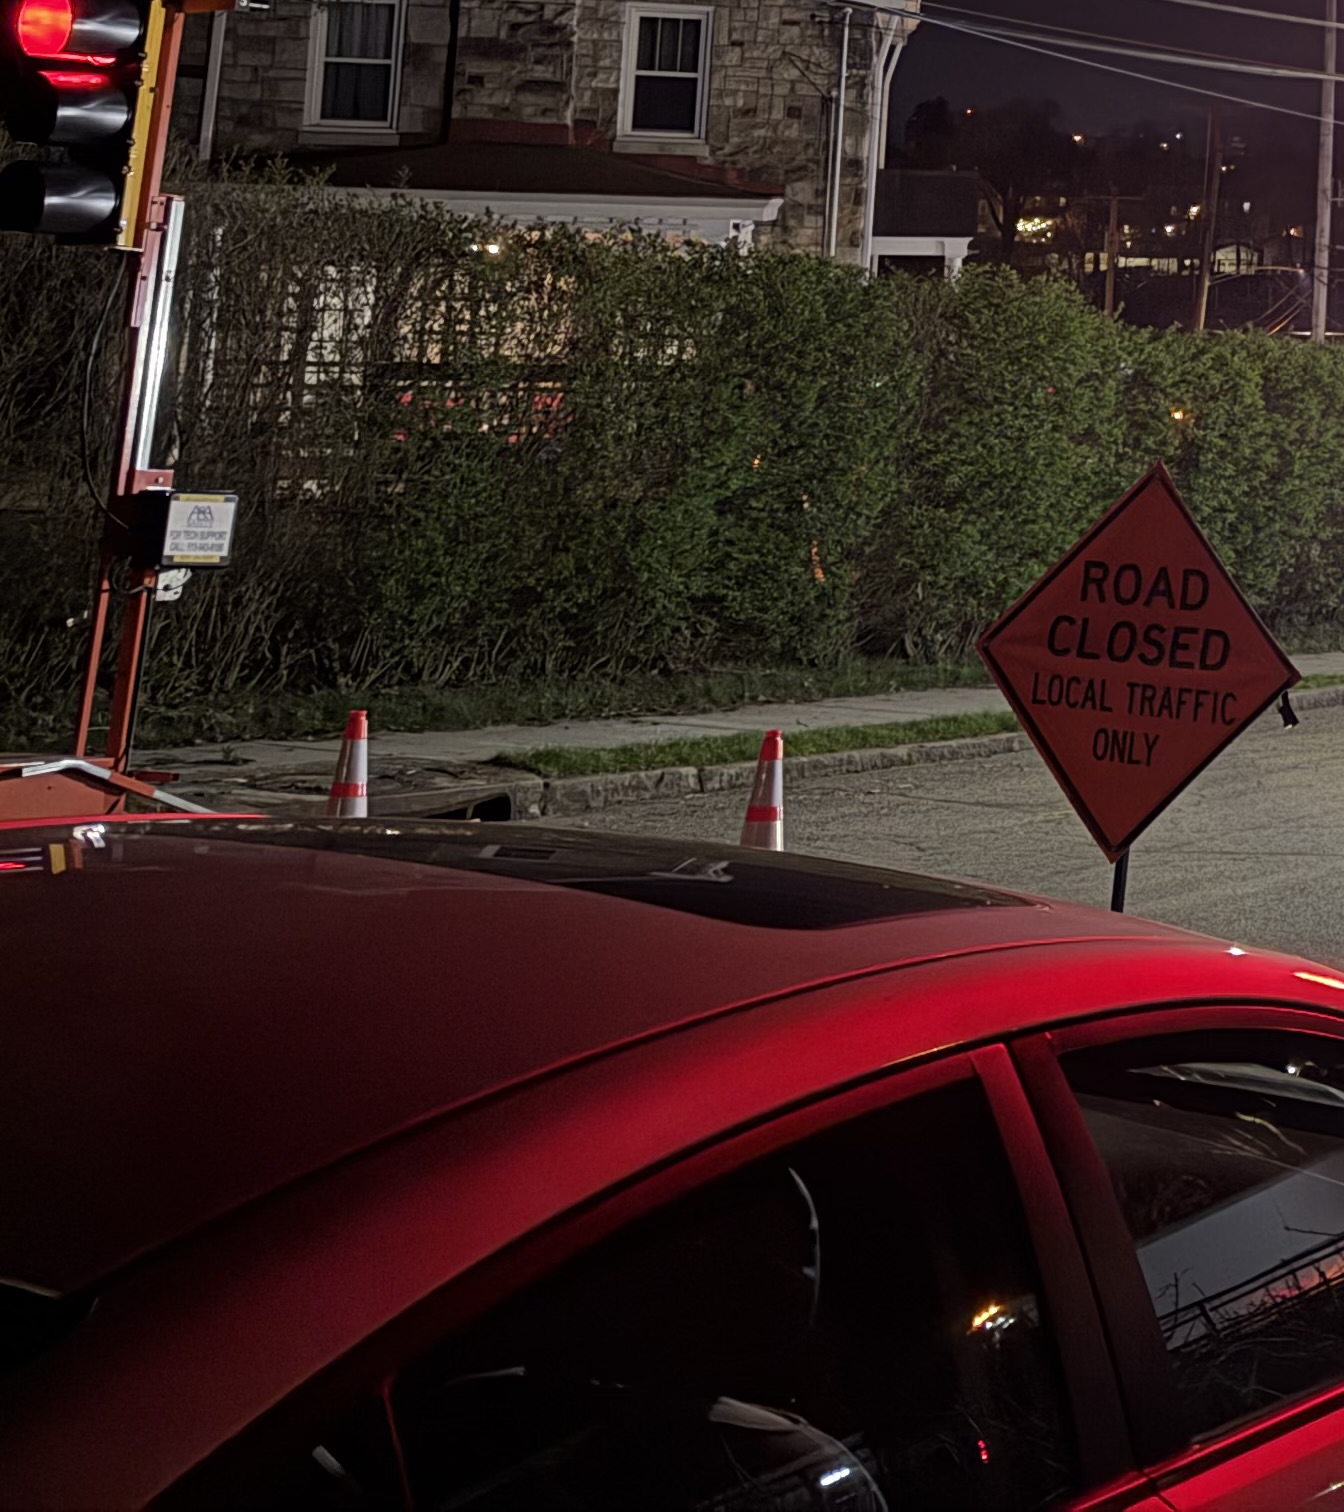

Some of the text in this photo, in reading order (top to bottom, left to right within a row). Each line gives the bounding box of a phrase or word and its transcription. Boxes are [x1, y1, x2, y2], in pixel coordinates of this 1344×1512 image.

[199, 530, 228, 541] SUPPORT
[1080, 559, 1210, 611] ROAD
[1047, 615, 1232, 671] CLOSED
[1031, 671, 1238, 726] LOCAL TRAFFIC
[1092, 727, 1160, 767] ONLY
